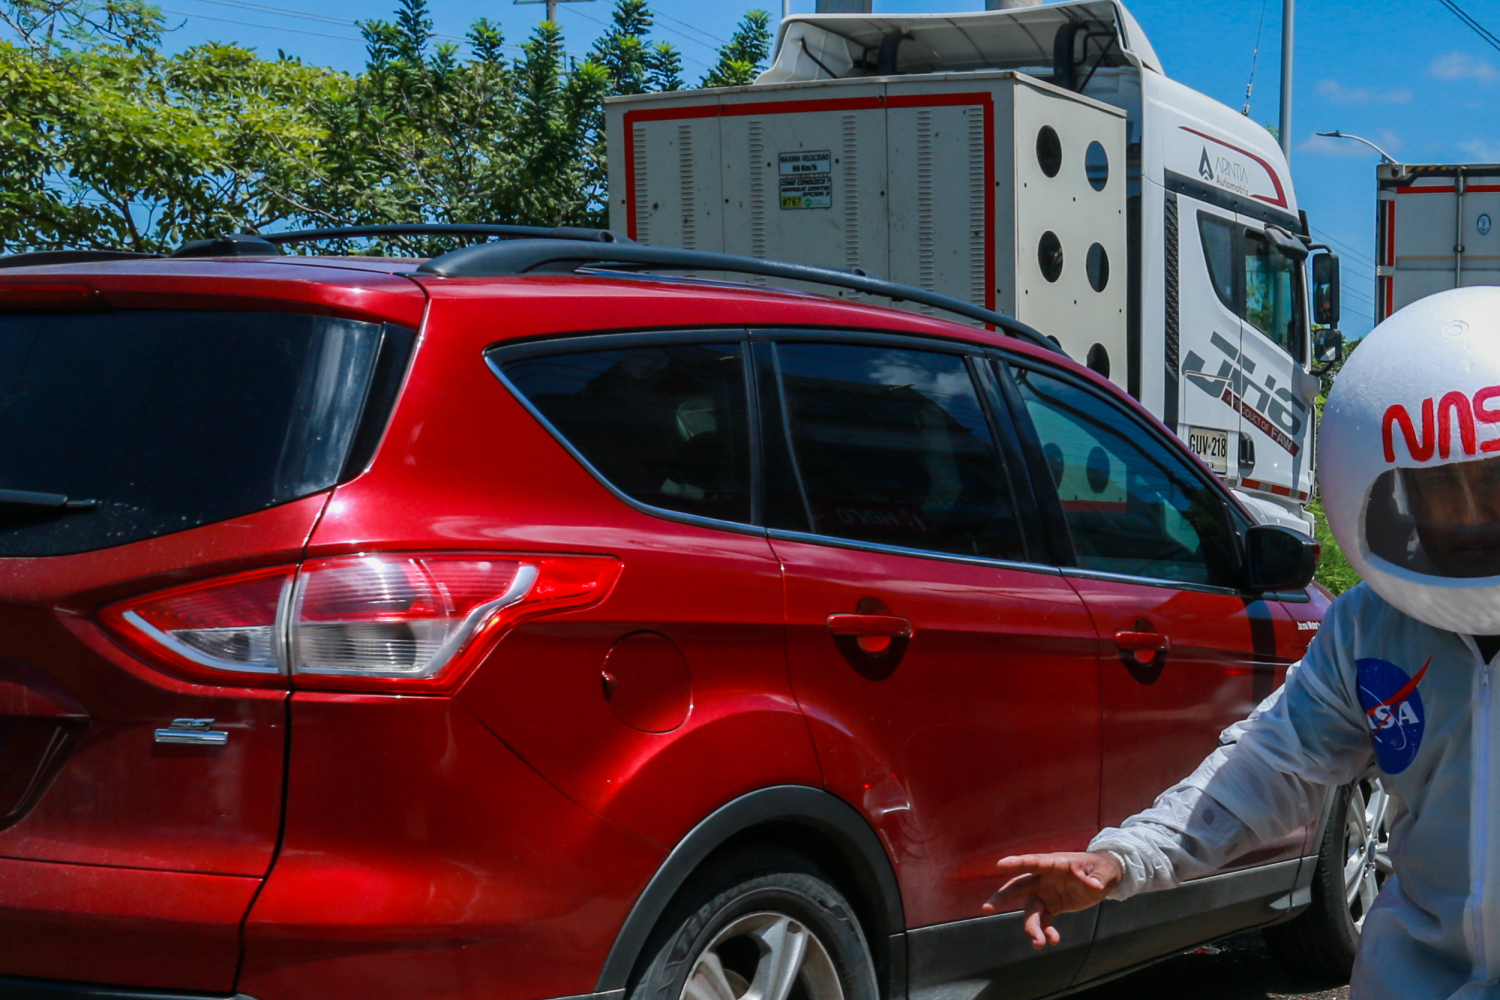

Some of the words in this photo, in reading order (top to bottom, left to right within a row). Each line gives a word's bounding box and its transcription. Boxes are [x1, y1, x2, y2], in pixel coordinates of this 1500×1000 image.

[1216, 175, 1249, 197] Automotriz
[782, 196, 801, 207] #767
[1260, 420, 1270, 432] OF
[1270, 427, 1293, 451] FAW
